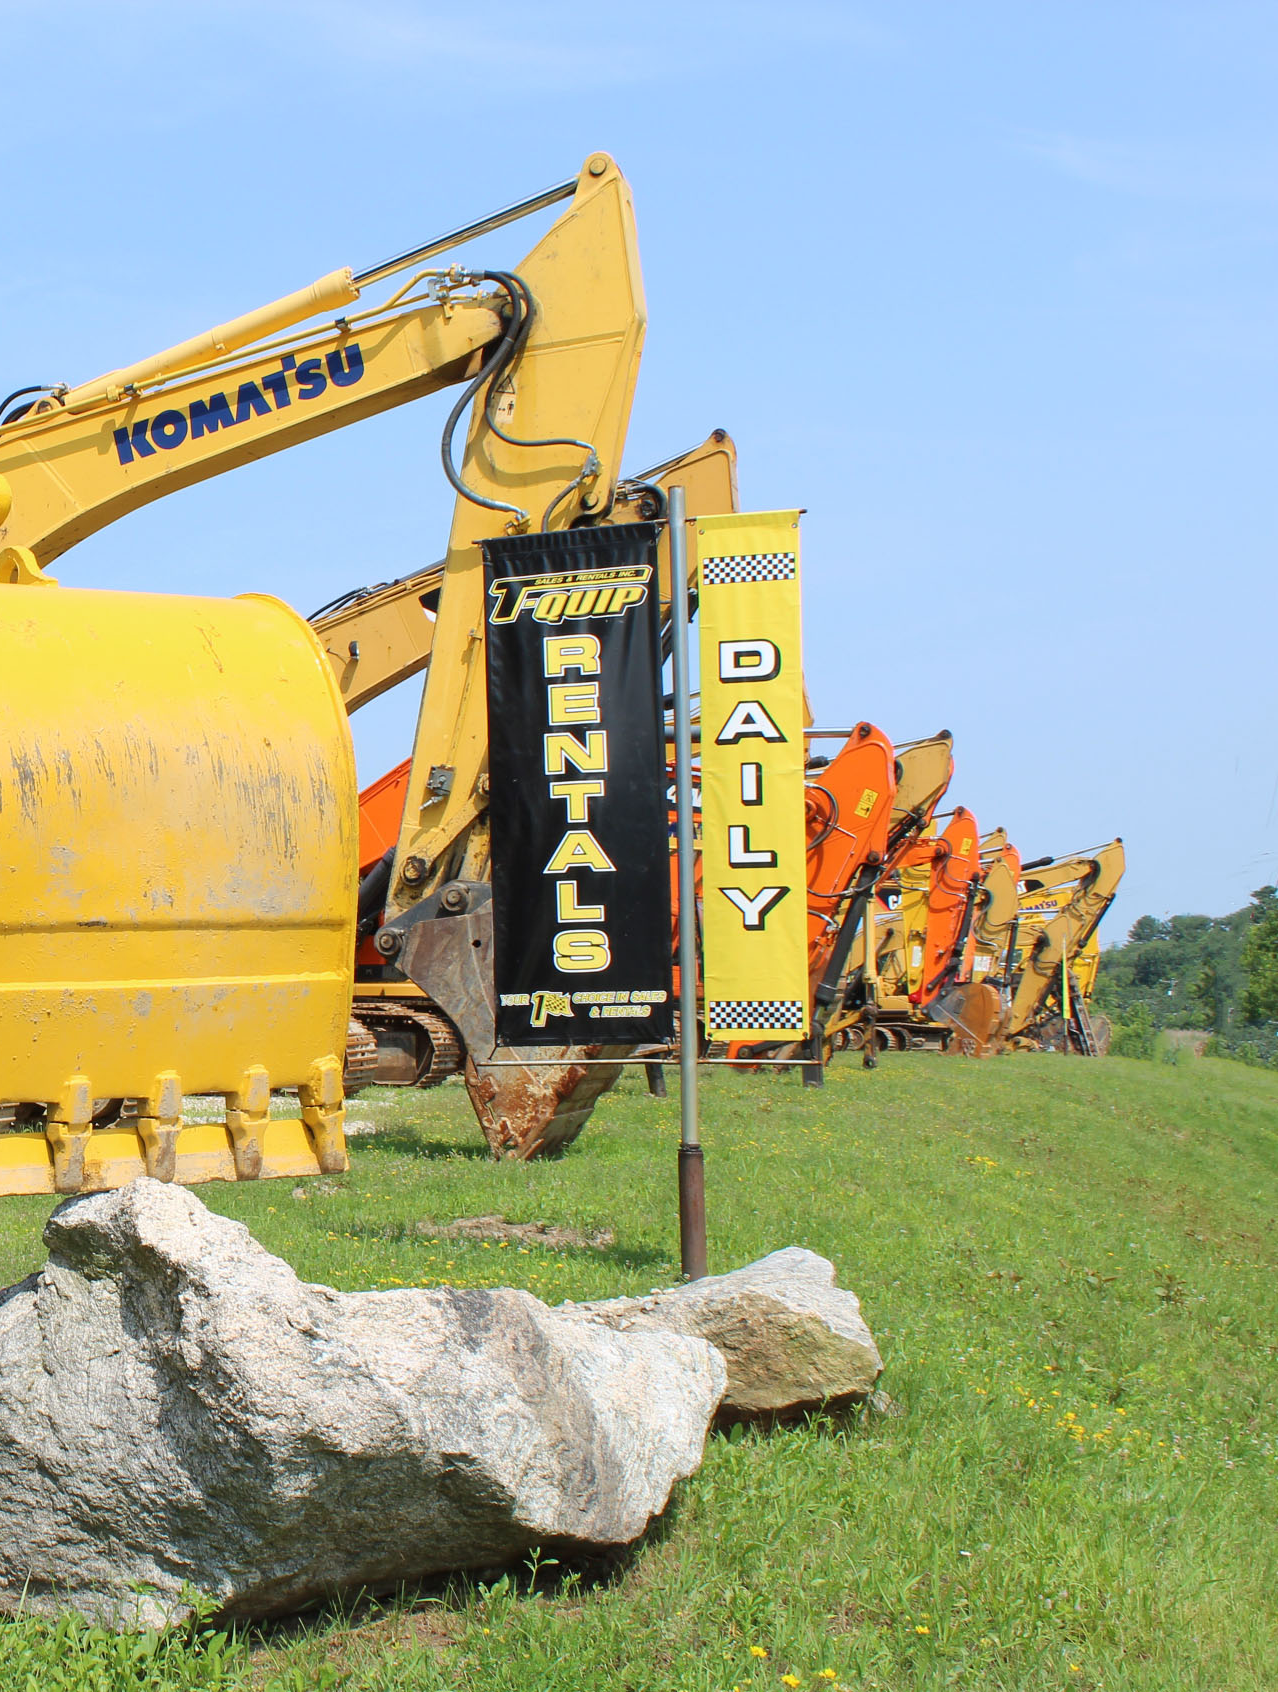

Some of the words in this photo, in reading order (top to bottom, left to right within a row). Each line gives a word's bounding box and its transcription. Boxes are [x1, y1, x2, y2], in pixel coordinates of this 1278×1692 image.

[112, 342, 365, 466] KOMATSU
[533, 576, 564, 586] SALES
[575, 571, 616, 581] RENTALS
[616, 570, 637, 578] INC.
[543, 634, 617, 973] RENTALS
[715, 639, 791, 931] DAILY
[500, 994, 530, 1006] YOUR
[572, 991, 616, 1004] CHOICE
[616, 991, 630, 1004] IN
[630, 990, 667, 1003] SALES
[589, 1005, 600, 1018] &
[601, 1005, 652, 1017] RENTALS
